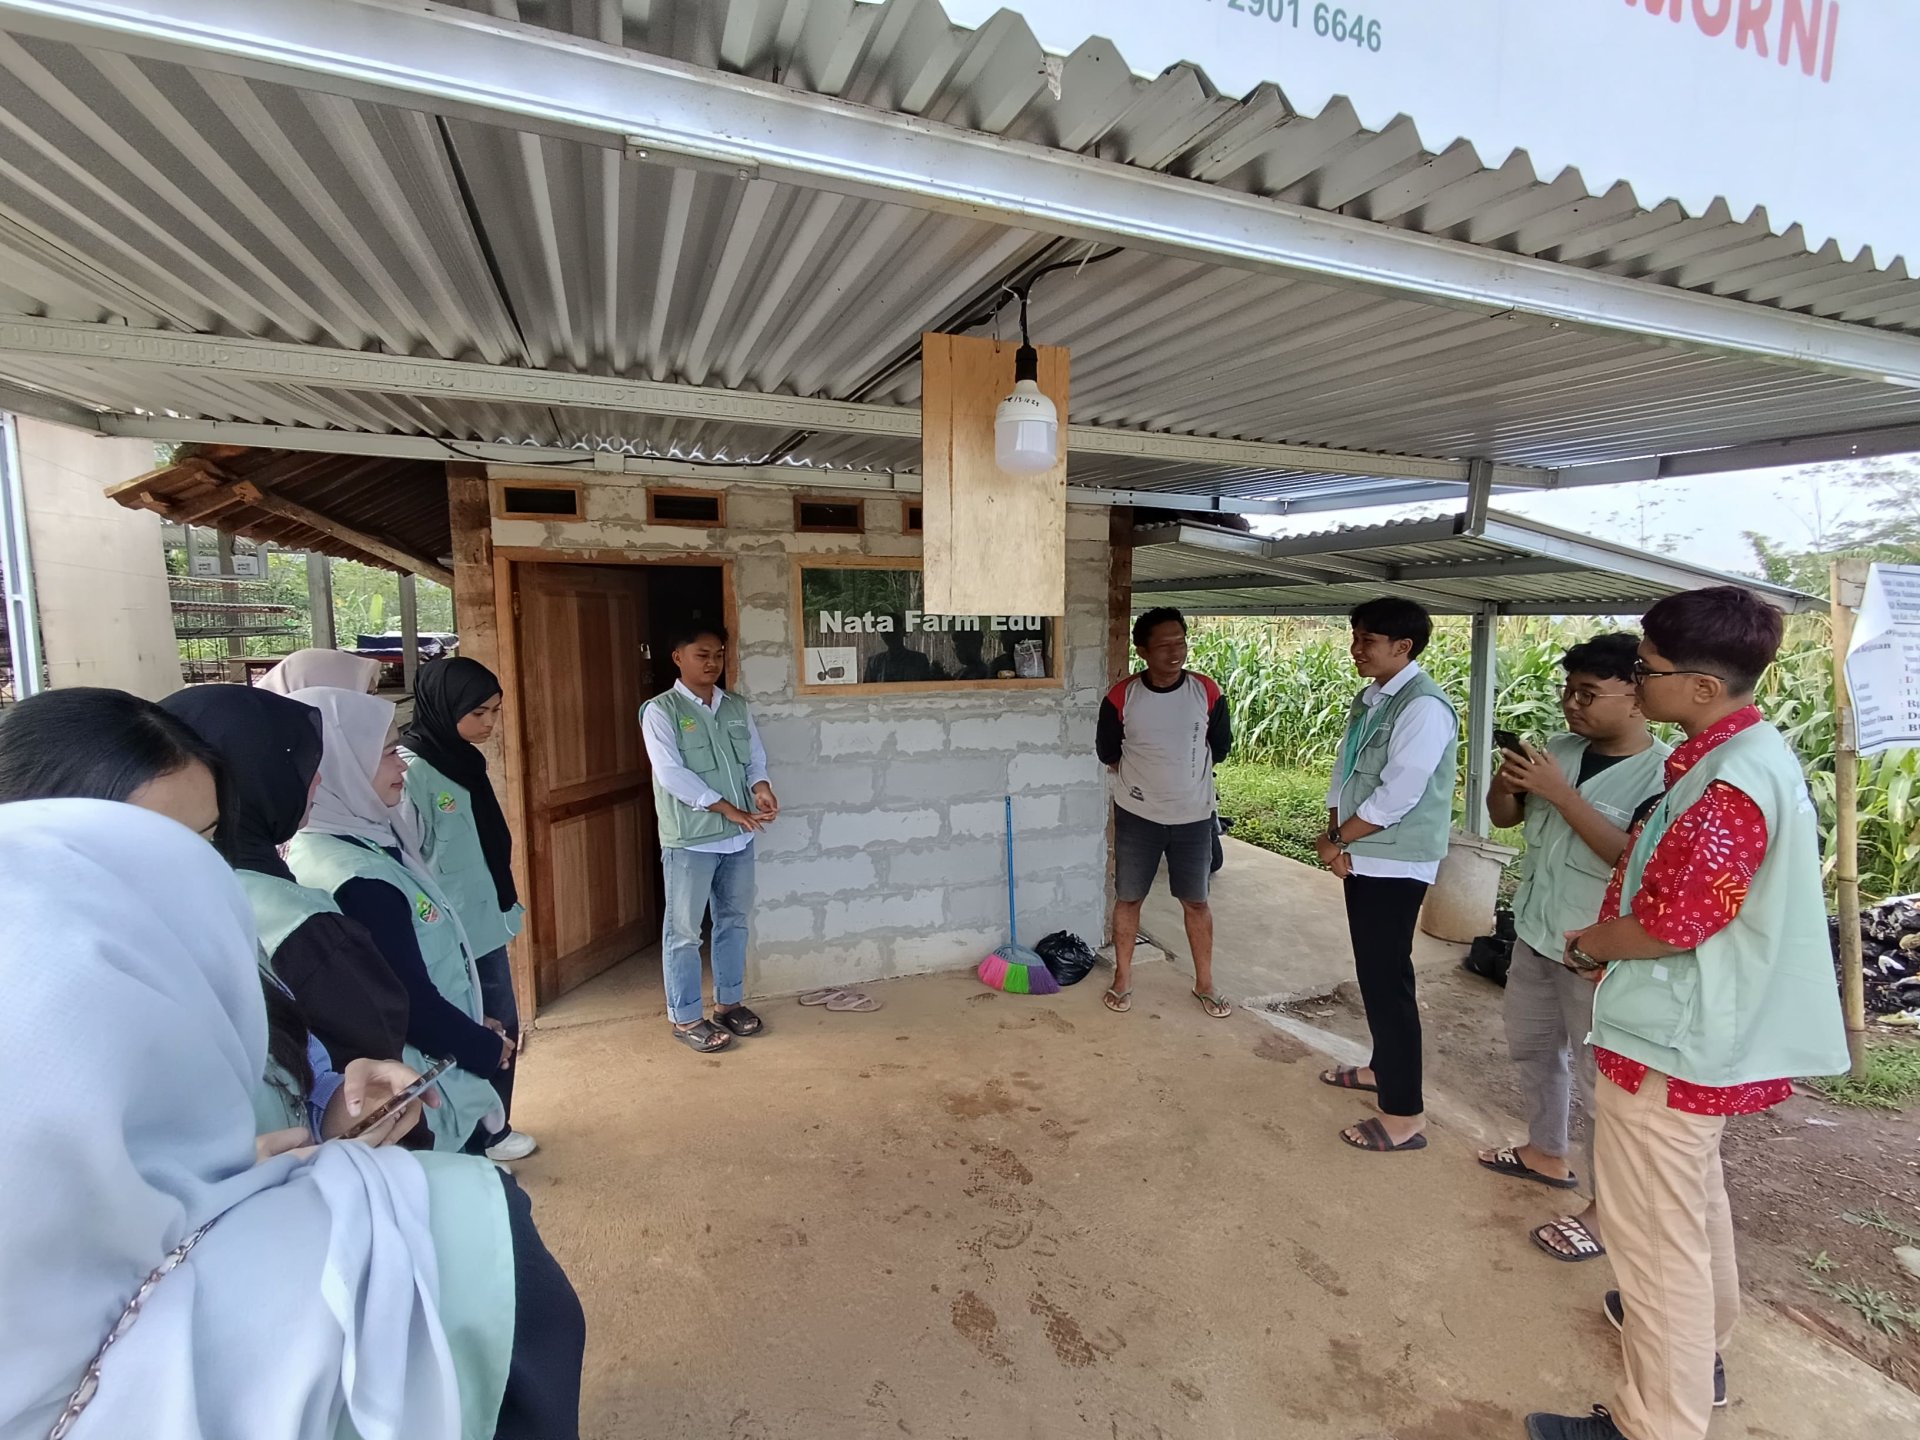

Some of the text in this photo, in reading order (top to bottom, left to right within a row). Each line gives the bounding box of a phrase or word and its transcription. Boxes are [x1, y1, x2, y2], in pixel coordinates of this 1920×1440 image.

[1313, 2, 1382, 52] 6646
[1624, 0, 1840, 83] RNI
[820, 610, 1041, 633] Nata Farm Edu
